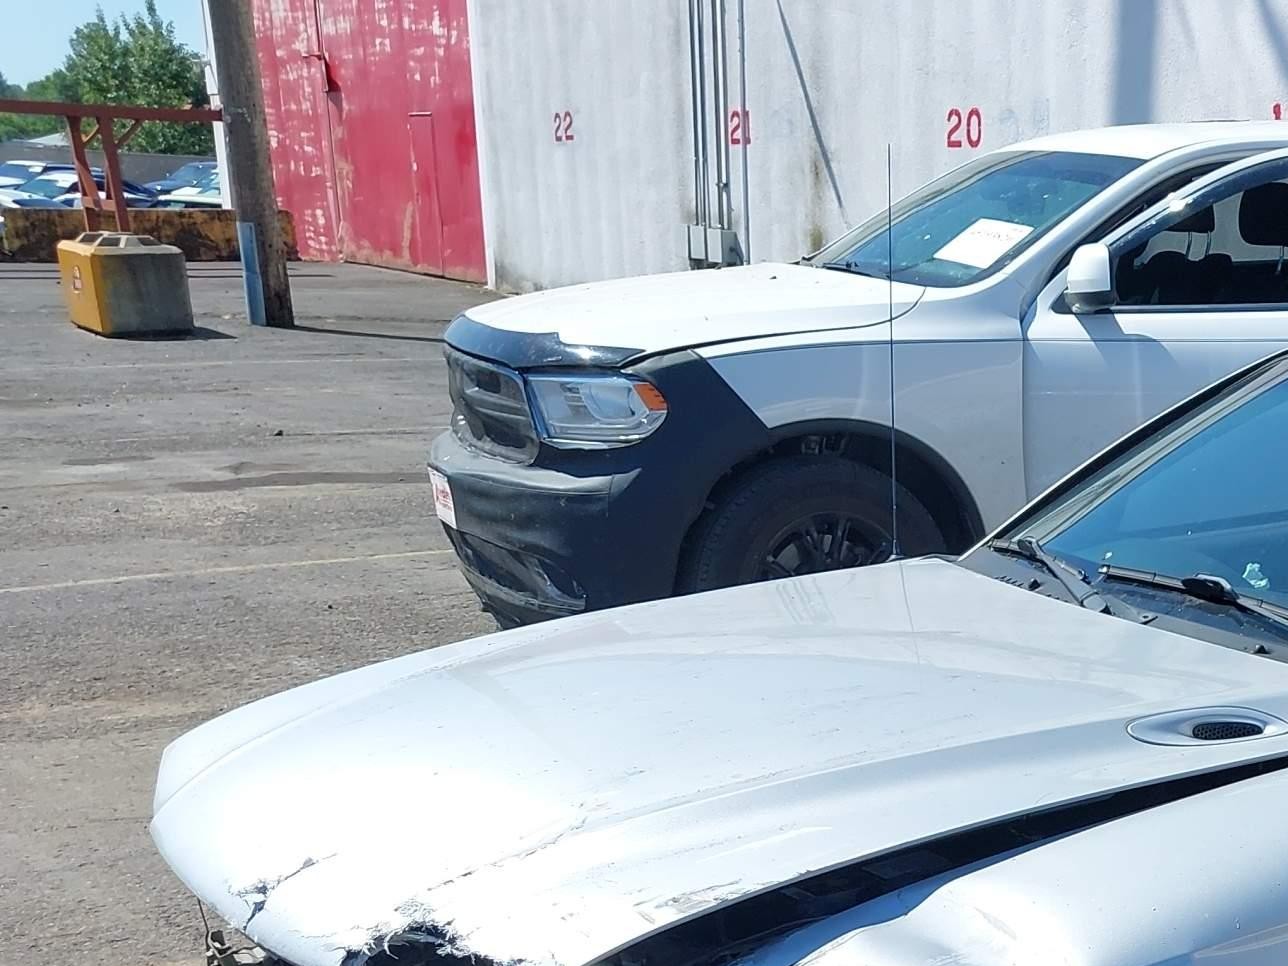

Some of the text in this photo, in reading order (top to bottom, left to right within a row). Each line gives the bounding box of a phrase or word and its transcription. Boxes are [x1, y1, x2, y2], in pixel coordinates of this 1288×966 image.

[553, 111, 575, 142] 22
[729, 110, 752, 145] 21
[946, 107, 982, 149] 20
